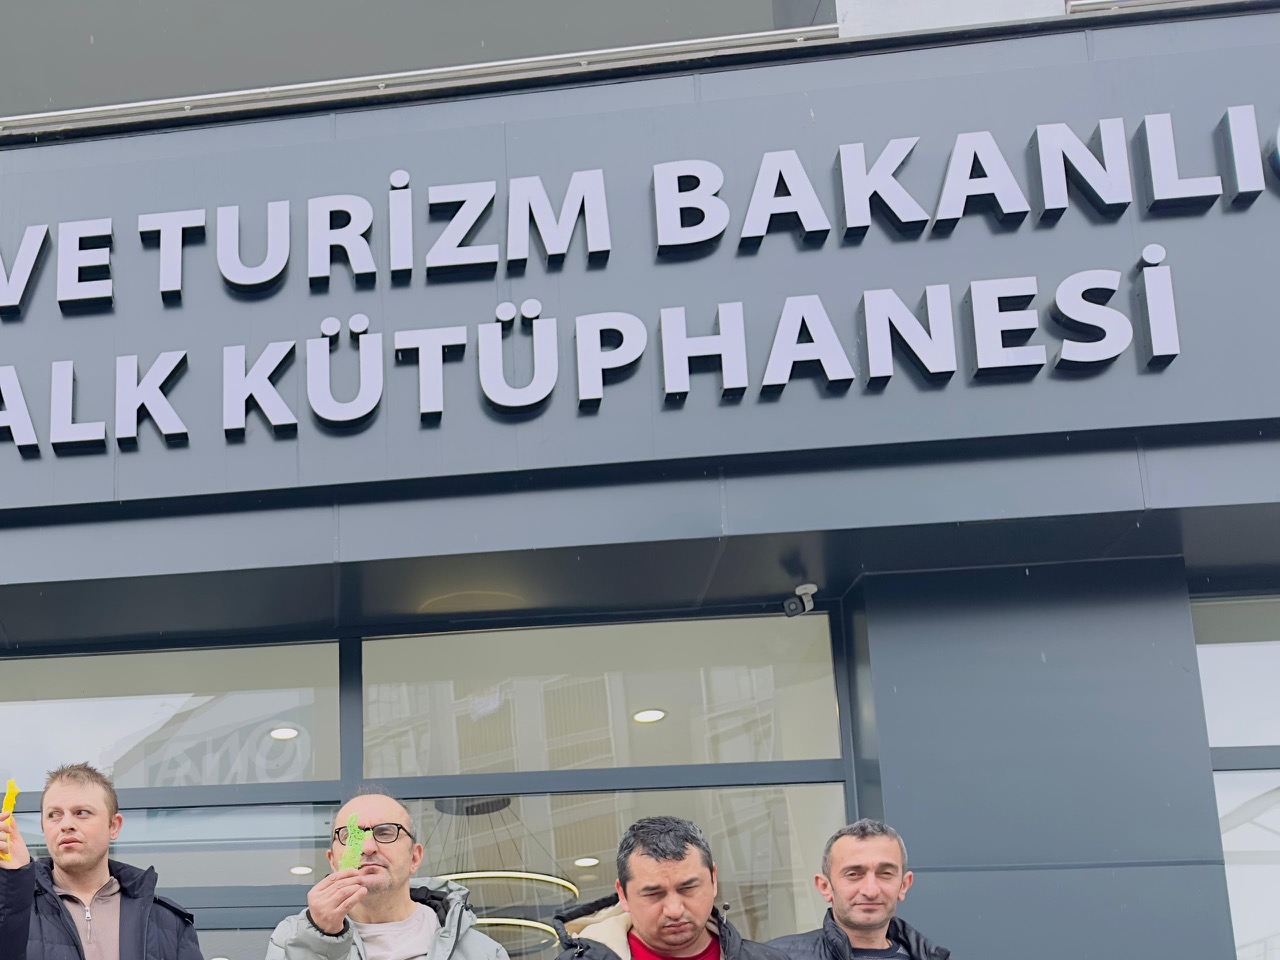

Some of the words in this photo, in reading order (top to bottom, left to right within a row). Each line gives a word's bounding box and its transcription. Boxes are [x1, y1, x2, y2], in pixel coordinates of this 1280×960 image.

[138, 168, 612, 292] TURİZM
[653, 104, 1280, 245] BAKANLI
[224, 243, 1181, 429] KÜTÜPHANESİ
